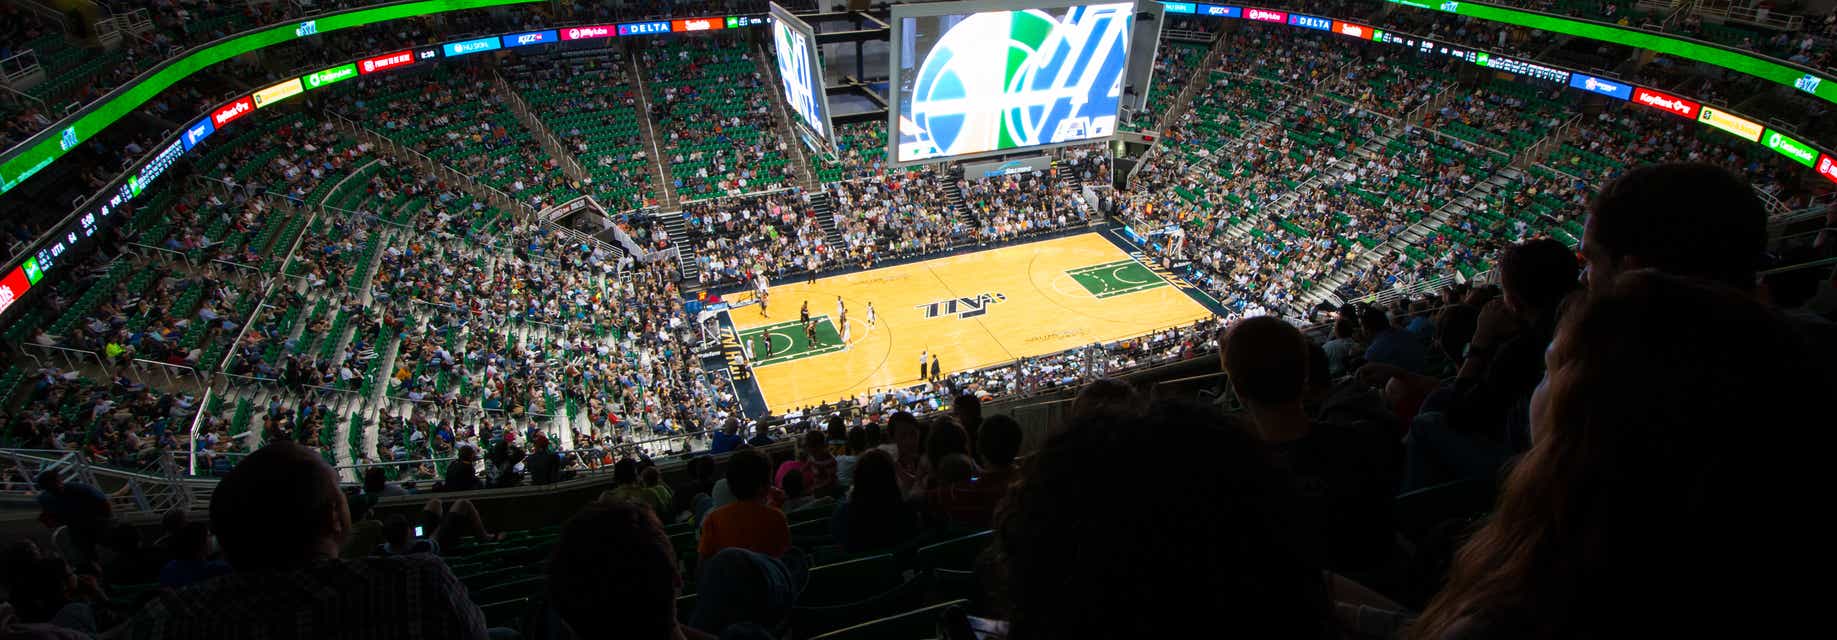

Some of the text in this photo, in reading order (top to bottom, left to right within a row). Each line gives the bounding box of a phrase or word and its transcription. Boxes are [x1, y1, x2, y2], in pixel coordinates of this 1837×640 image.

[631, 23, 668, 33] DELTA
[1300, 17, 1329, 29] DELTA
[1640, 92, 1673, 109] KeyBank
[110, 194, 122, 208] POR
[51, 242, 65, 257] UTA
